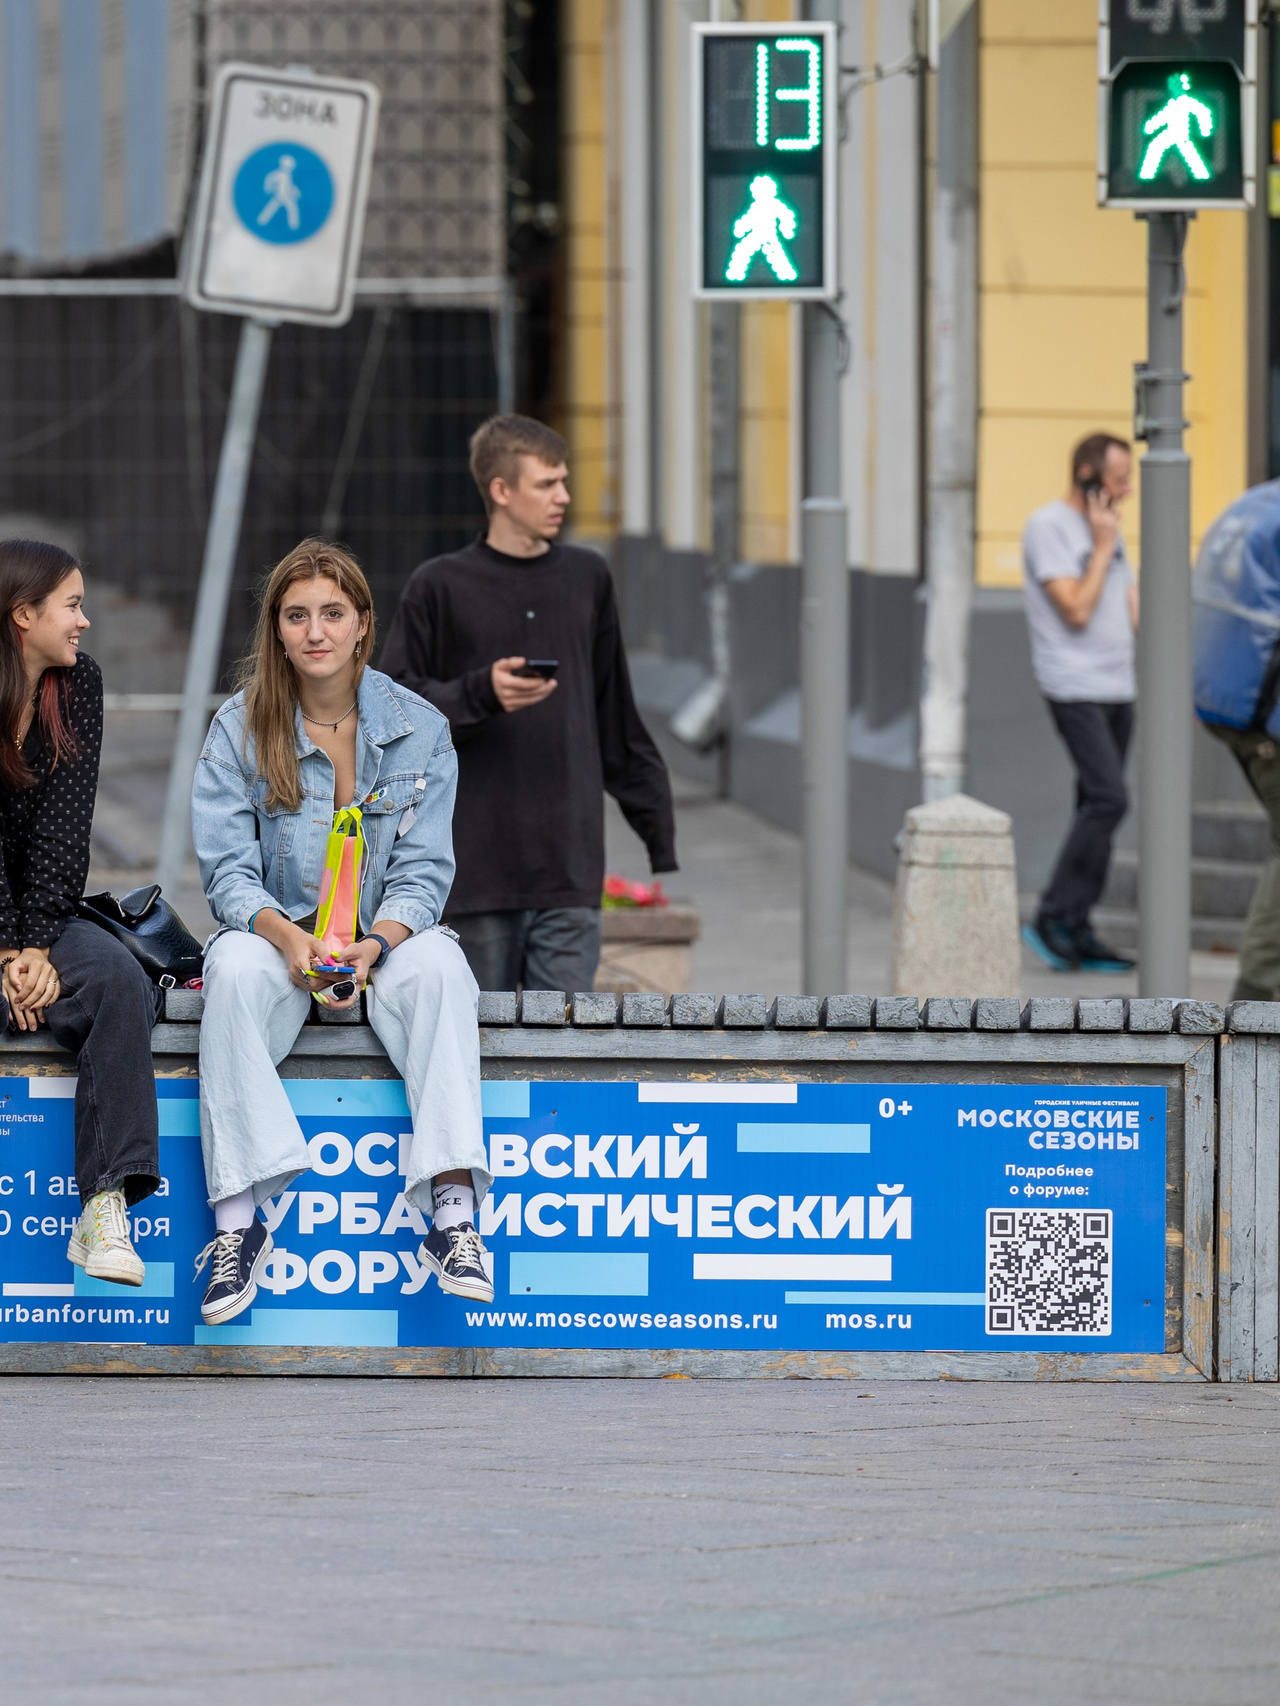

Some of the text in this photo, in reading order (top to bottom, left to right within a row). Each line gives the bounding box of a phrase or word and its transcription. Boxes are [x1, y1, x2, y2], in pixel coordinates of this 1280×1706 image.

[756, 39, 820, 150] 13
[253, 90, 339, 127] ЗОНА
[878, 1097, 913, 1118] 0+
[957, 1108, 1140, 1129] МОСКОВСКИЕ
[1028, 1130, 1140, 1150] СЕЗОНЫ
[302, 1123, 708, 1180] ОСВСКИЙ
[23, 1169, 37, 1195] 1
[1005, 1164, 1094, 1181] Подробнее
[1009, 1183, 1089, 1198] о форуме:
[261, 1183, 913, 1240] УРБАИСТИЧЕСКИЙ
[465, 1310, 912, 1330] www.moscowseasons.ru mos.ru
